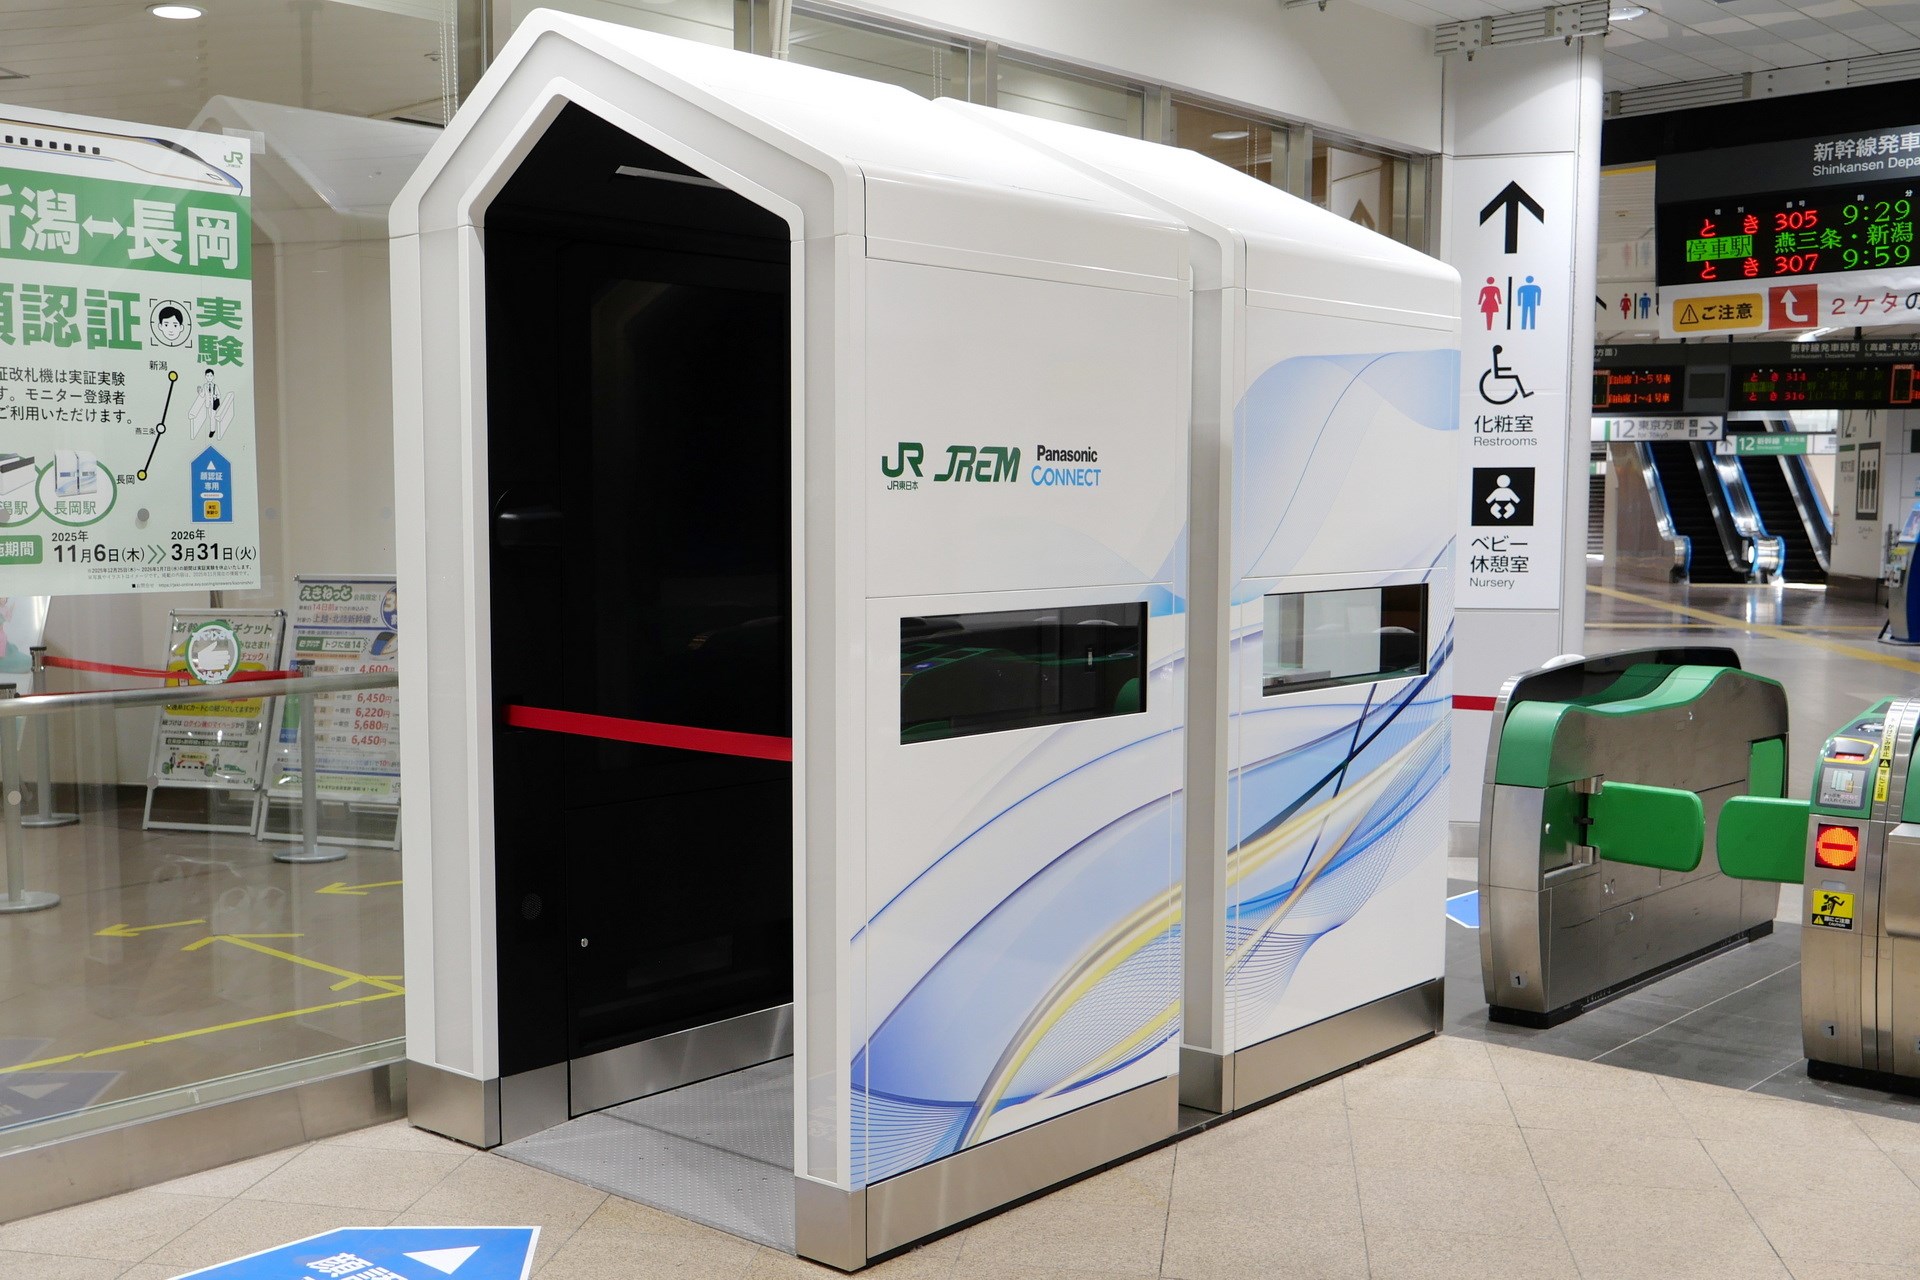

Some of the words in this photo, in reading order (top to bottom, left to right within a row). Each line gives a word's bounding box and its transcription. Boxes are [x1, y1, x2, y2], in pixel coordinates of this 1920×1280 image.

[224, 151, 243, 164] JR
[1812, 160, 1884, 176] Shinkansen
[0, 184, 80, 255] 潟
[1774, 209, 1818, 232] 305
[1842, 199, 1911, 226] 9:29
[1688, 235, 1751, 261] 停車駅
[1774, 221, 1914, 255] 燕三条・新潟
[1774, 253, 1819, 275] 307
[1842, 244, 1911, 270] 9:59
[1701, 302, 1753, 321] ご注意
[196, 296, 244, 368] 実験
[149, 360, 168, 371] 新潟
[1474, 415, 1534, 434] 化粧室
[1612, 420, 1635, 439] 12
[1638, 420, 1685, 431] 東京方面
[1473, 435, 1538, 447] Restrooms
[1739, 437, 1755, 451] 12
[882, 441, 924, 478] JR
[1036, 444, 1098, 463] Panasonic
[933, 444, 1022, 483] JREM
[116, 474, 135, 485] 長岡
[1030, 465, 1102, 487] CONNECT
[887, 480, 919, 491] JR東日本
[54, 500, 96, 515] 長岡駅
[51, 530, 89, 542] 2025年
[171, 529, 206, 541] 2026年
[1471, 536, 1528, 552] ベビー
[1470, 555, 1529, 573] 休憩室
[1469, 577, 1515, 588] Nursery
[300, 585, 352, 601] えきねっと
[1514, 975, 1521, 985] 1
[1828, 1025, 1834, 1036] 1
